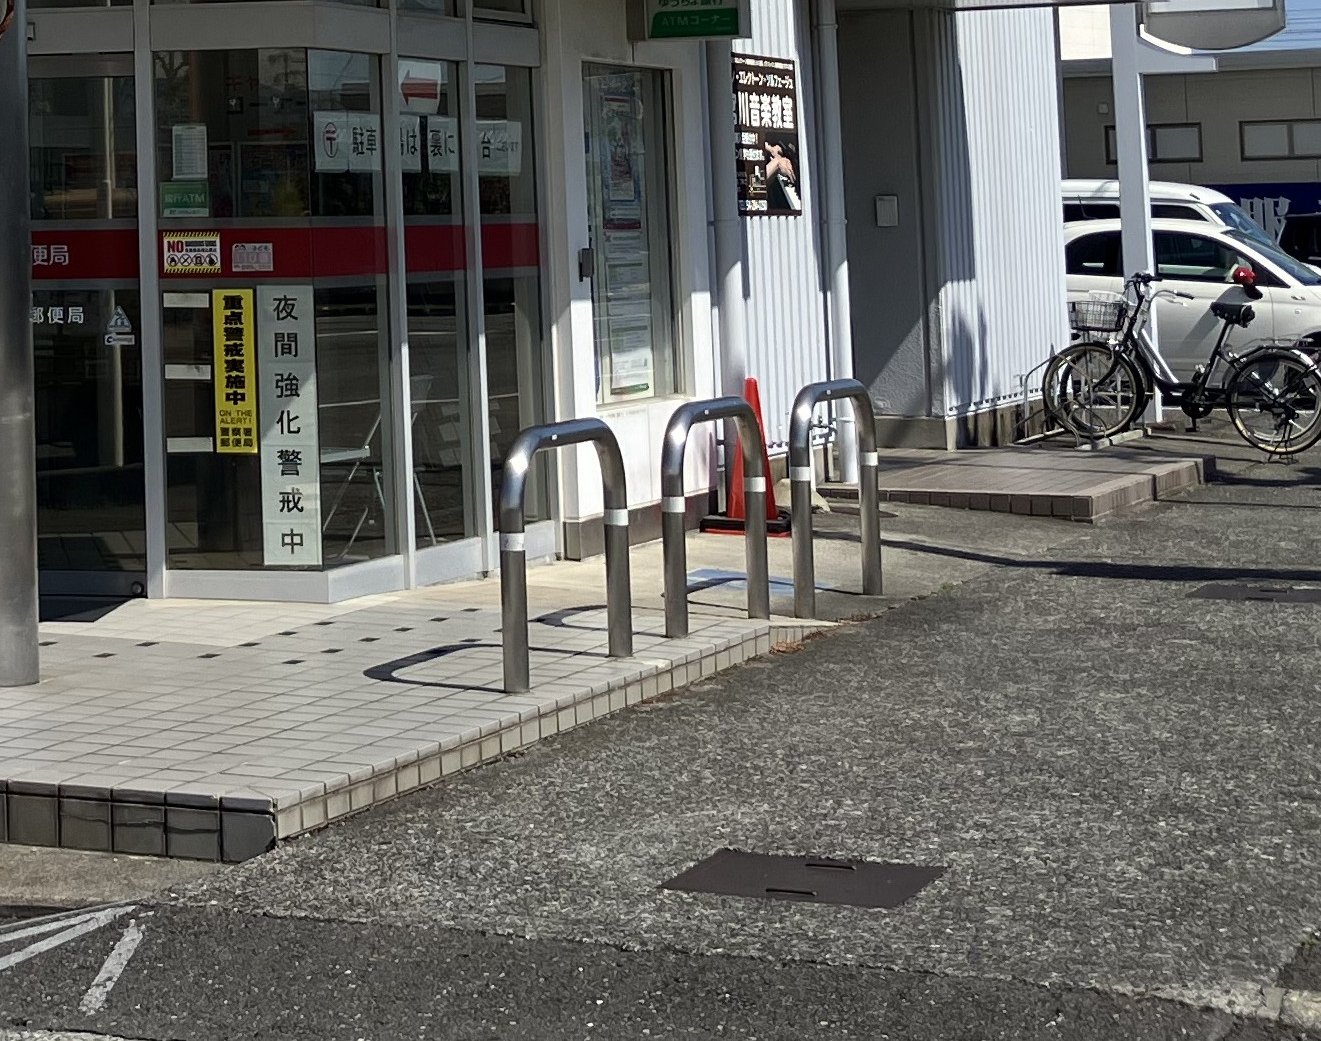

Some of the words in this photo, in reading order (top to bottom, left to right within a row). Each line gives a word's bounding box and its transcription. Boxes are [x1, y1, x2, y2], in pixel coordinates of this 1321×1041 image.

[732, 91, 794, 129] 川音楽教室
[167, 240, 184, 253] NO
[223, 295, 246, 406] 重点警戒実施中
[220, 438, 254, 448] 郵便局
[272, 295, 304, 555] 夜間強化警戒中
